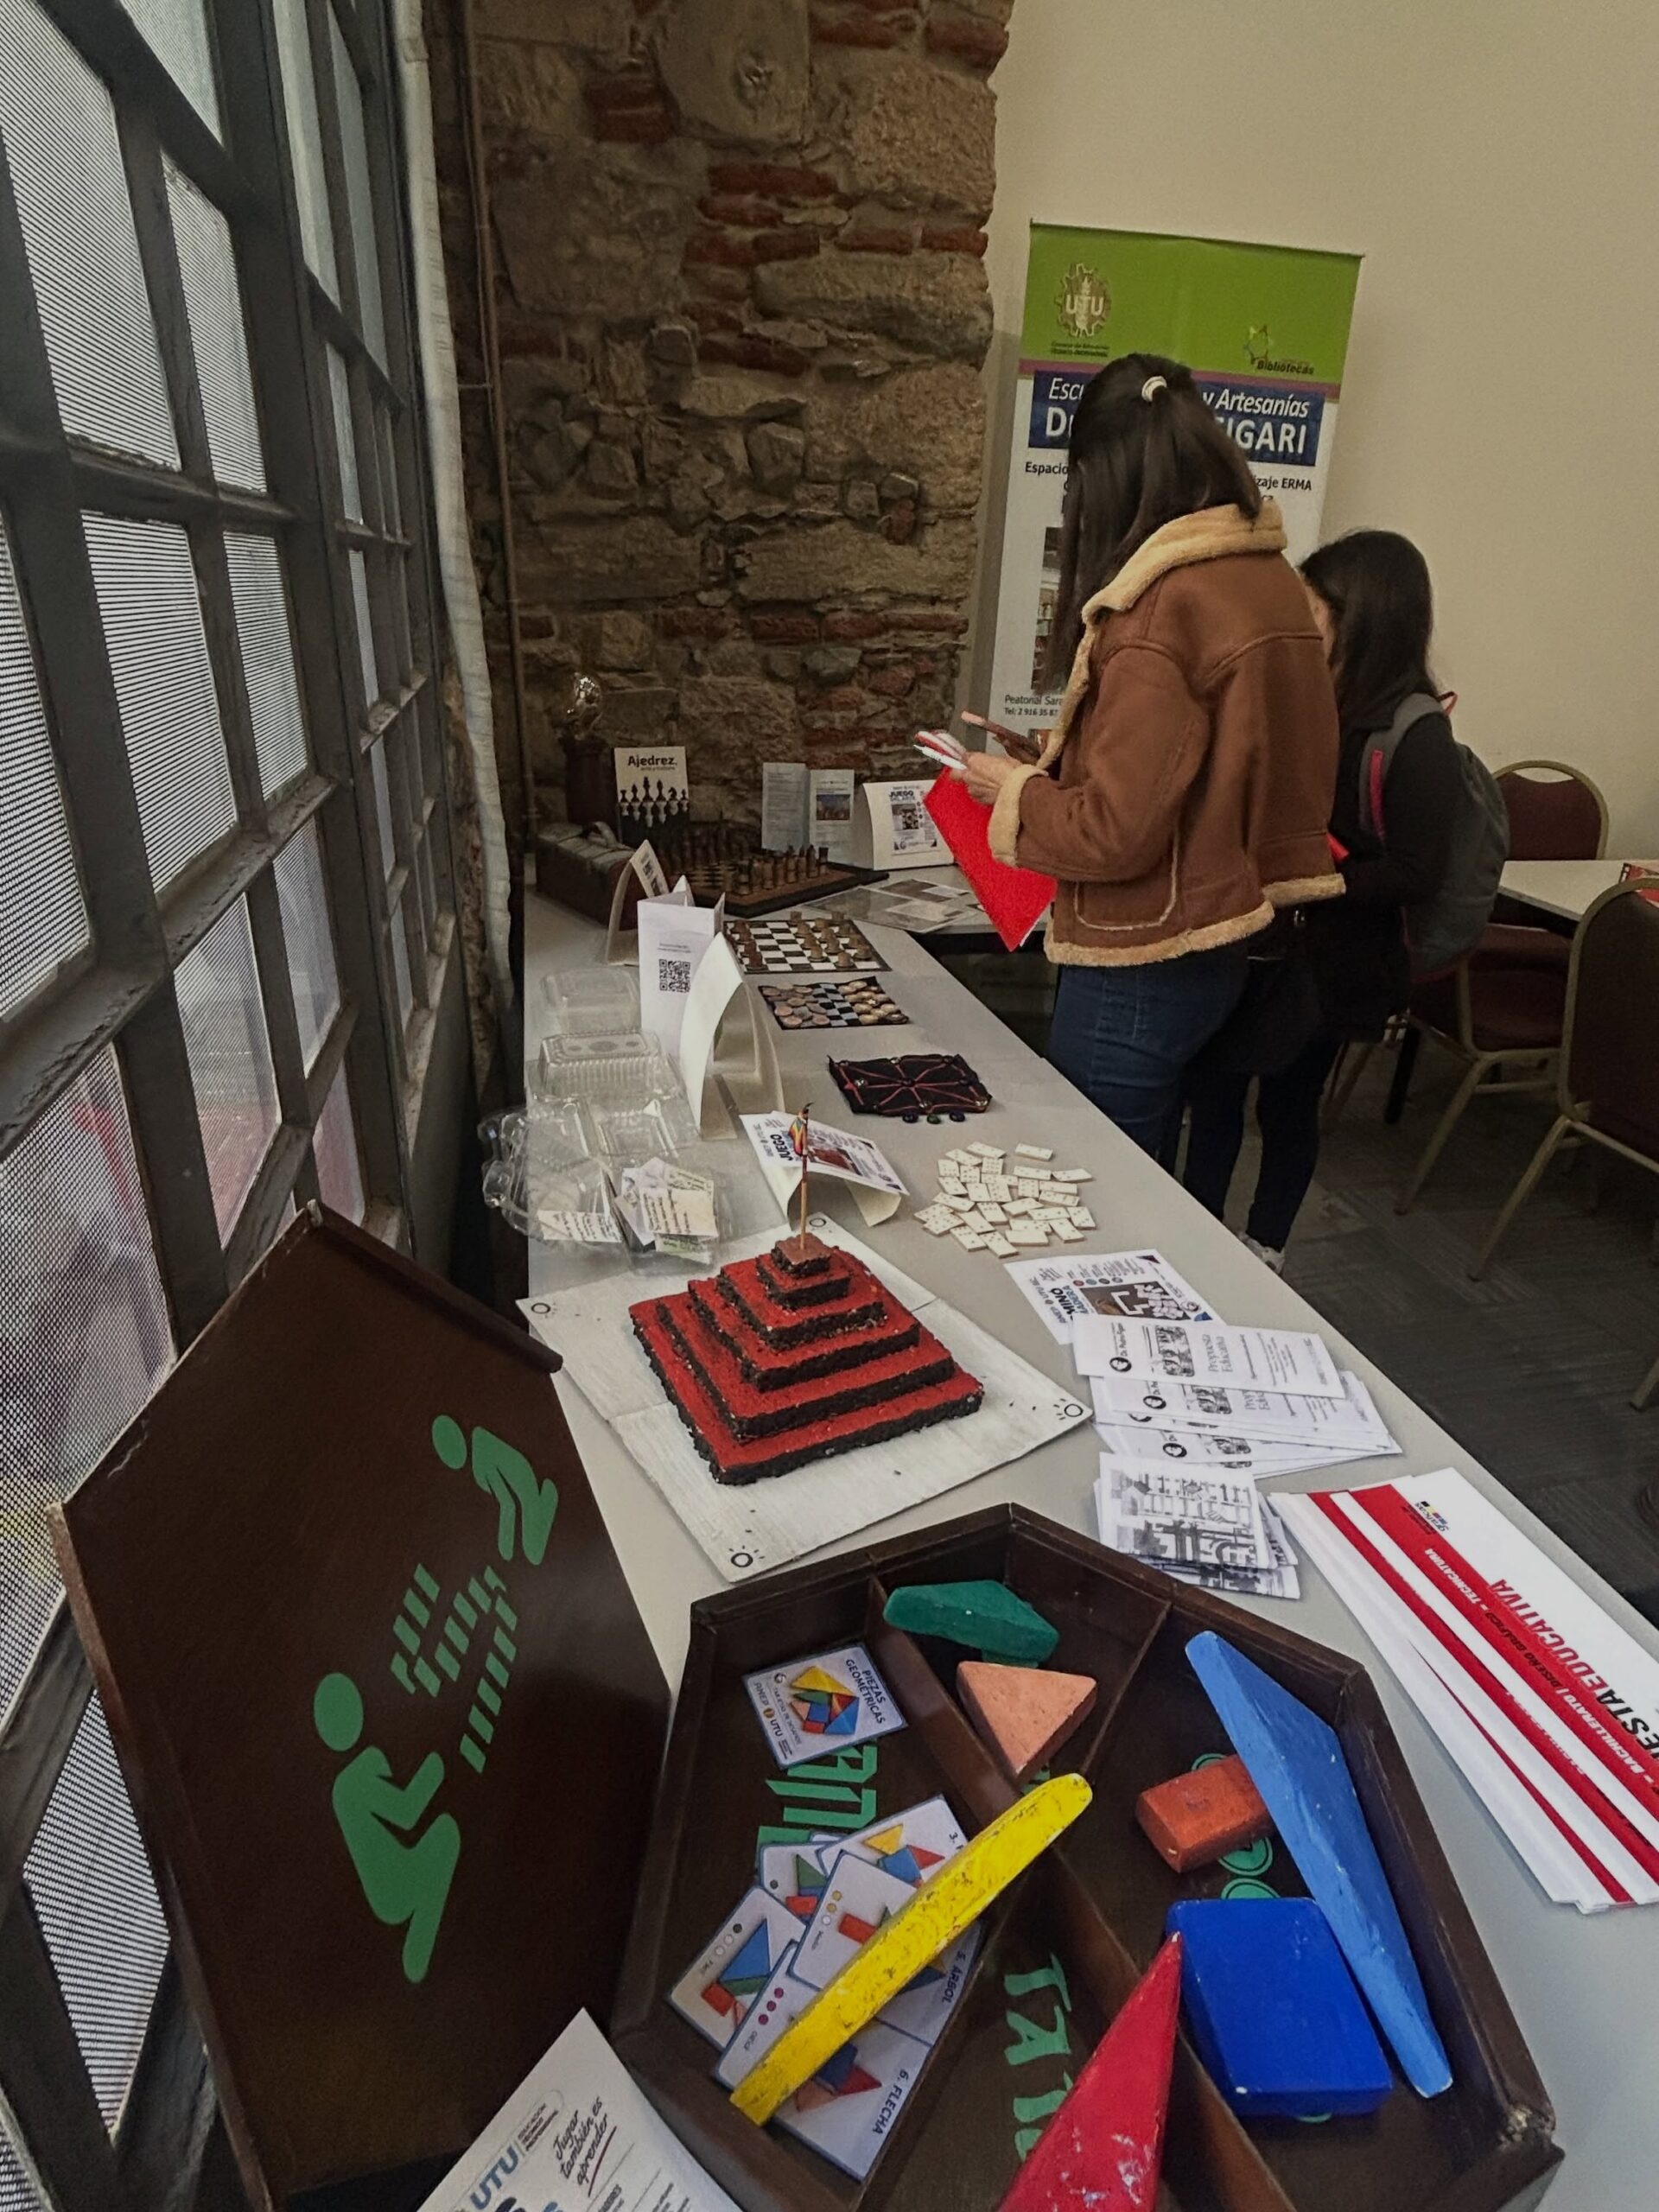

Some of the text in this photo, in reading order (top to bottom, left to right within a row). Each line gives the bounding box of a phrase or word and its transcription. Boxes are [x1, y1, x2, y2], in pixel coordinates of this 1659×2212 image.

[1065, 294, 1104, 316] UTU
[1256, 359, 1314, 375] Bibliotecas
[1214, 388, 1311, 418] Artesanías
[1215, 416, 1307, 454] IGARI
[1025, 461, 1069, 477] Espacio
[1281, 477, 1313, 491] ERMA
[1005, 695, 1042, 705] Peatonal
[628, 755, 676, 768] Ajedrez
[770, 1134, 793, 1161] JUEGO
[1049, 1287, 1076, 1320] MINÓ
[1424, 1548, 1482, 1604] TECNICATURA
[1484, 1611, 1527, 1652] GRÁFICO
[862, 1669, 887, 1704] PIEZAS
[1526, 1652, 1563, 1688] DISEÑO
[846, 1658, 886, 1725] GEOMÉTRICAS
[770, 1719, 784, 1738] UTU
[1564, 1694, 1645, 1774] BACHILLERATO
[872, 2069, 909, 2134] 6. FLECHA
[553, 2109, 579, 2160] Jugar
[560, 2096, 603, 2179] también es
[577, 2113, 607, 2185] aprender
[469, 2145, 519, 2210] UTU
